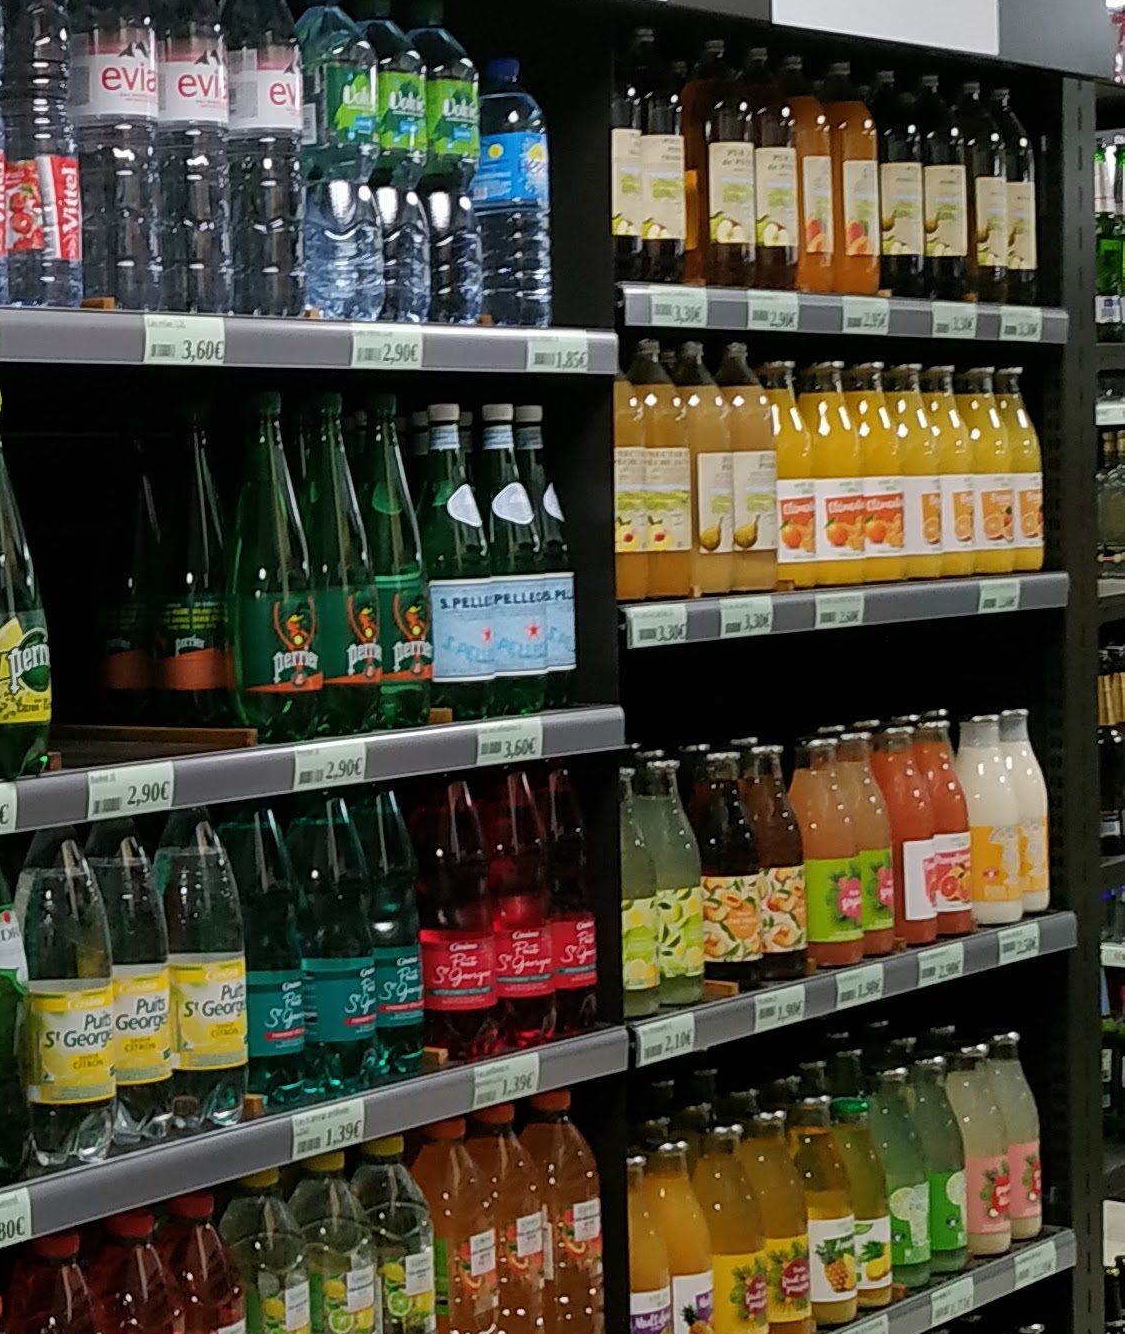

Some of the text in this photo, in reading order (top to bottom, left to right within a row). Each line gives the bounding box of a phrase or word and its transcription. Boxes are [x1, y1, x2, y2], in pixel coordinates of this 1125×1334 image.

[100, 60, 157, 94] evia
[60, 165, 80, 240] Vittel
[181, 339, 225, 362] 3,60€
[382, 343, 419, 365] 2,90€
[272, 644, 319, 683] perrier
[325, 757, 363, 781] 2,90€
[127, 780, 171, 807] 2,90€
[325, 1120, 362, 1148] 1,39€
